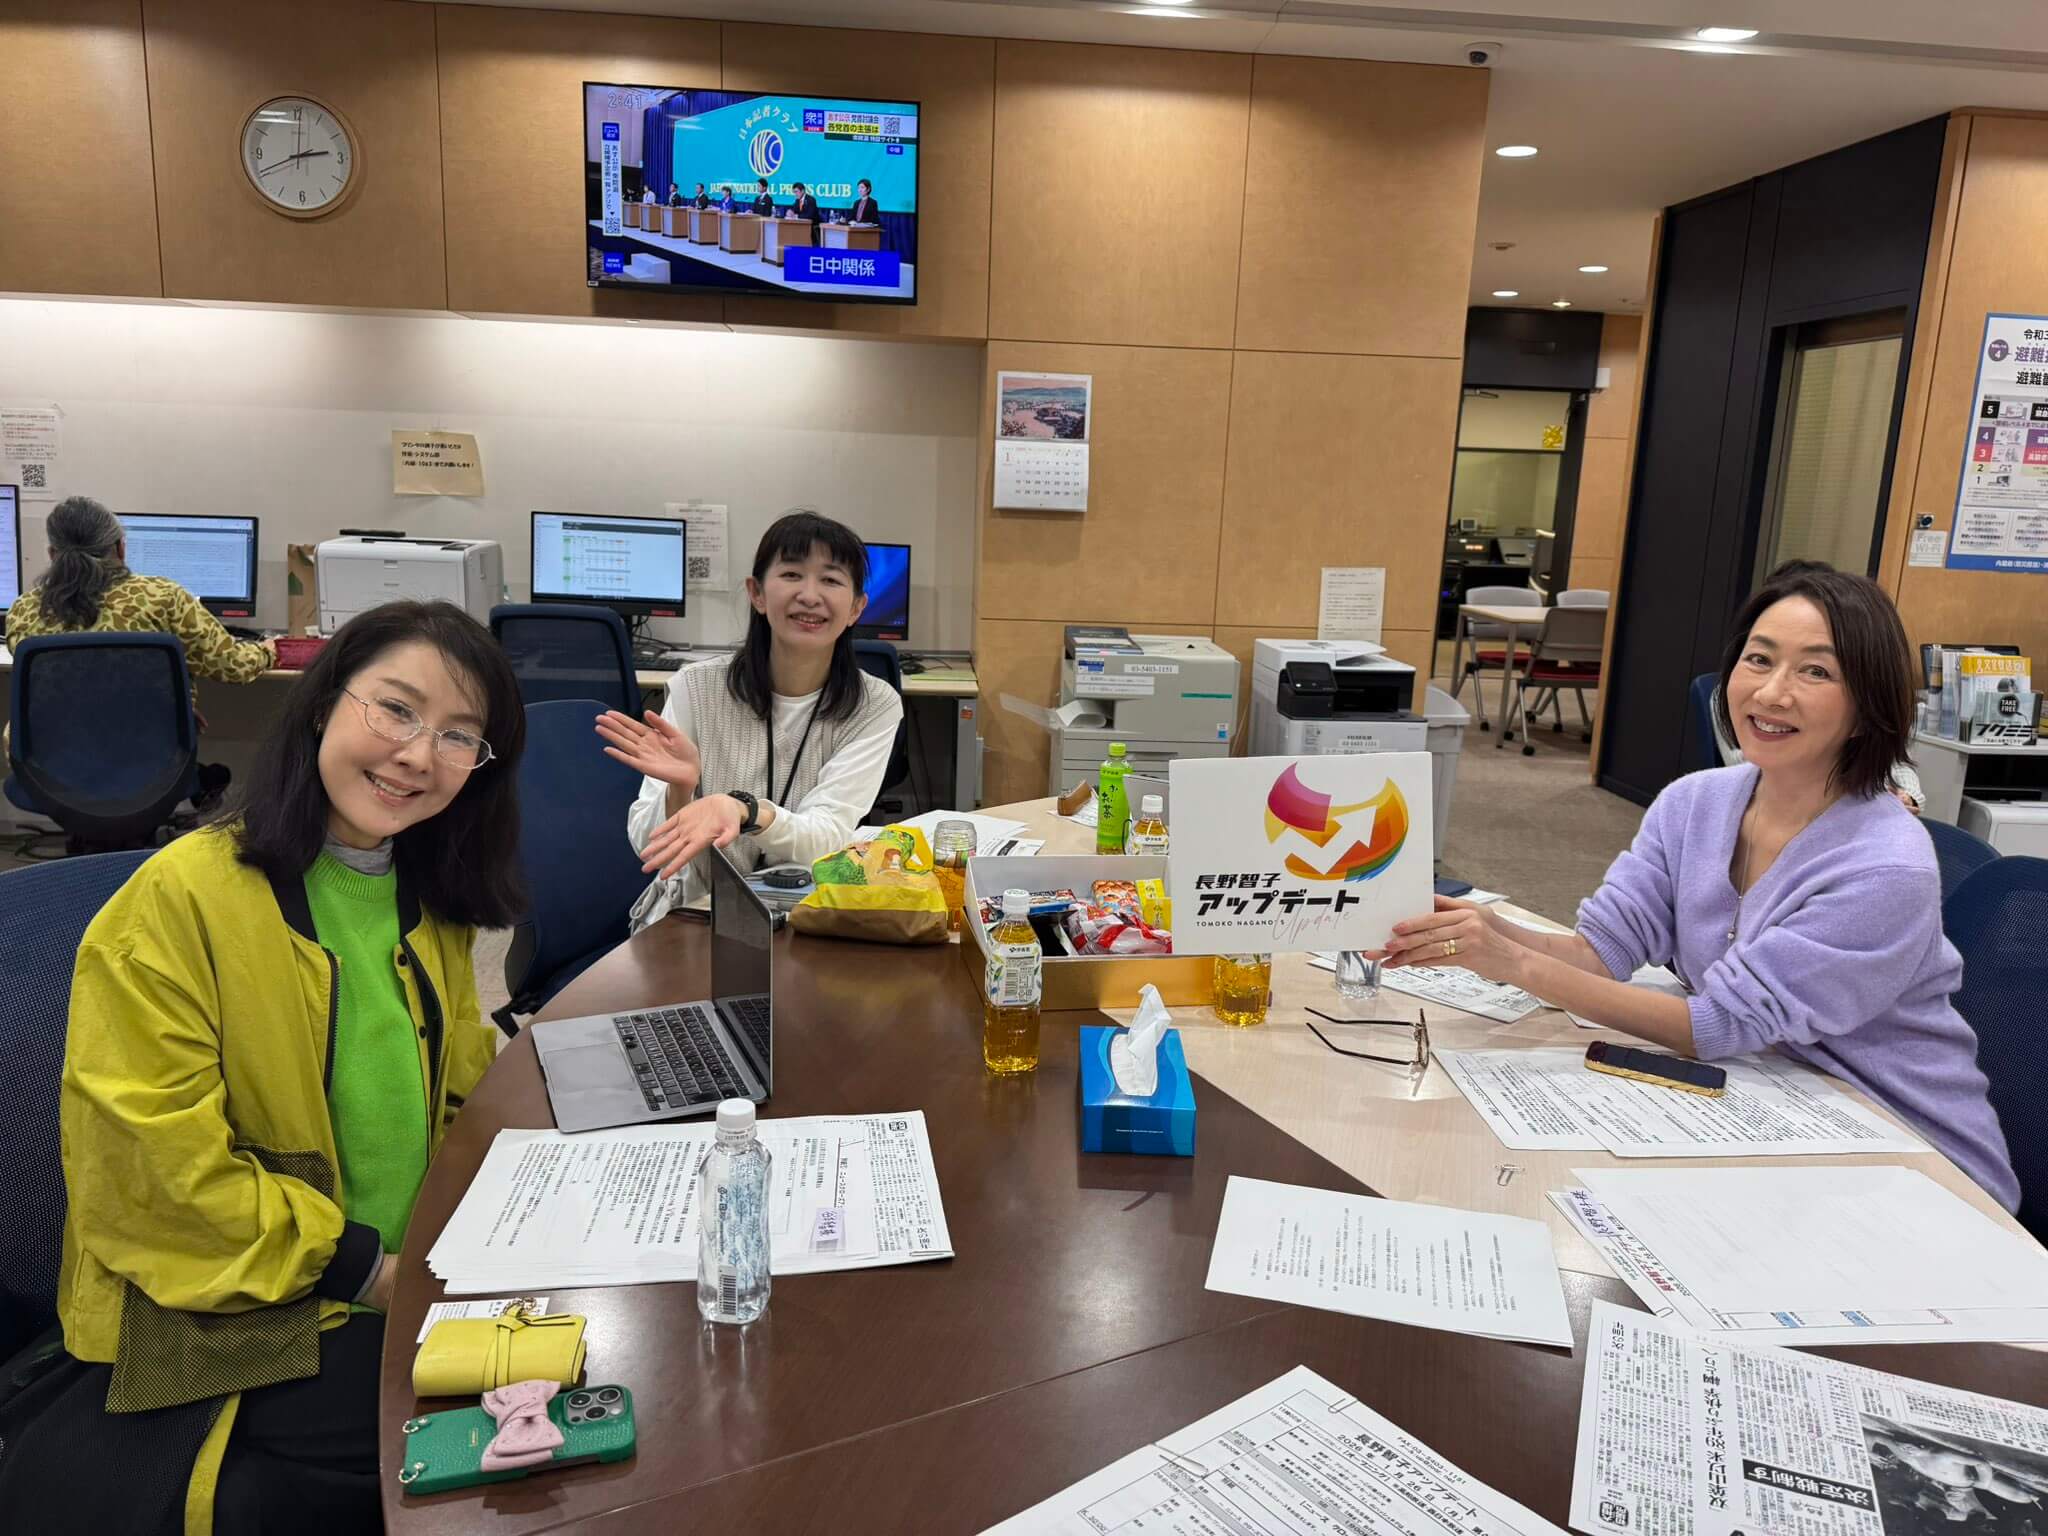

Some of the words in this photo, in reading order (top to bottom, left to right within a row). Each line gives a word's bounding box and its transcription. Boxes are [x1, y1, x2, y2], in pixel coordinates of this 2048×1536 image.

[608, 92, 643, 109] 2:41
[256, 147, 263, 160] 9
[337, 151, 344, 164] 3
[299, 191, 306, 203] 6
[816, 184, 852, 197] CLUB
[809, 256, 876, 277] 日中関係
[2015, 347, 2048, 363] 避難
[1987, 405, 1994, 414] 5
[1982, 431, 1989, 440] 4
[1979, 449, 1986, 458] 3
[1977, 464, 1984, 472] 2
[1976, 476, 1981, 484] 1
[1196, 873, 1281, 889] 長野智子
[1197, 889, 1360, 916] アップデート
[1196, 919, 1233, 927] TOMOKO
[1337, 1434, 1363, 1452] 2026
[1407, 1480, 1422, 1493] 26
[1354, 1433, 1478, 1518] 長野智子アップデート
[1749, 1464, 1870, 1506] 決定戦制す
